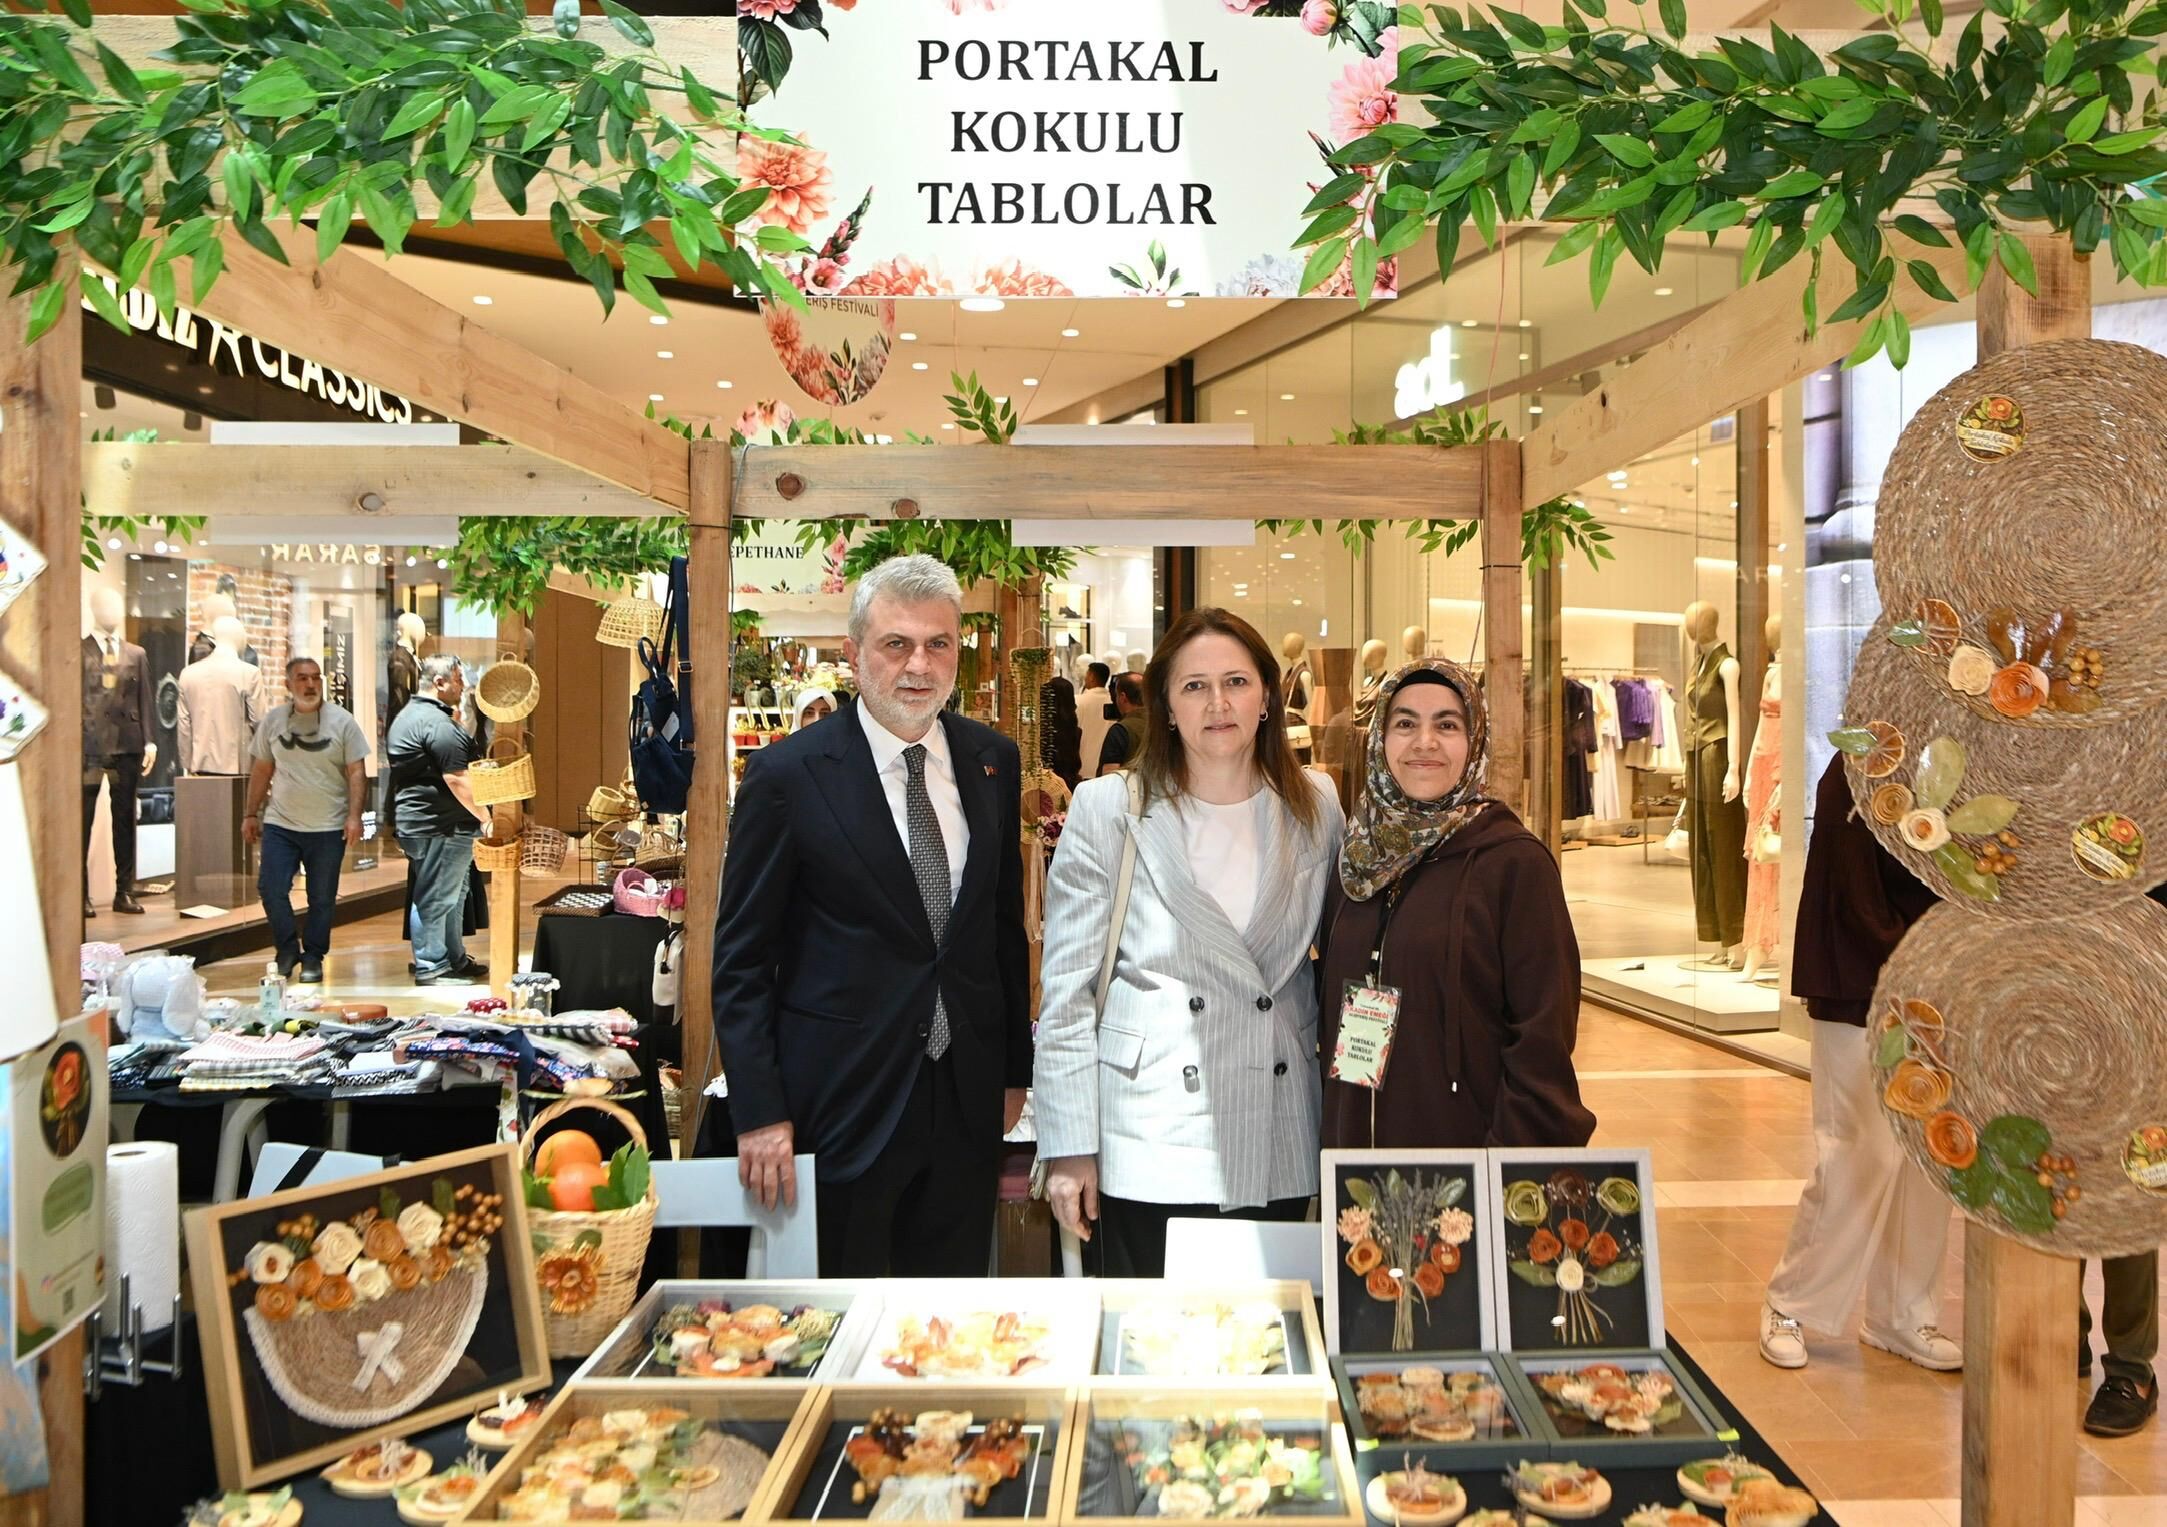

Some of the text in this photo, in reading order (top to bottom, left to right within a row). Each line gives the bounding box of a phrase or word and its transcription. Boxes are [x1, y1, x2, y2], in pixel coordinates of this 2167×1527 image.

[918, 40, 1217, 81] PORTAKAL
[951, 112, 1183, 152] KOKULU
[918, 183, 1216, 224] TABLOLAR
[1347, 1052, 1373, 1063] TABLOLAR
[1350, 1036, 1376, 1047] PORTAKAL
